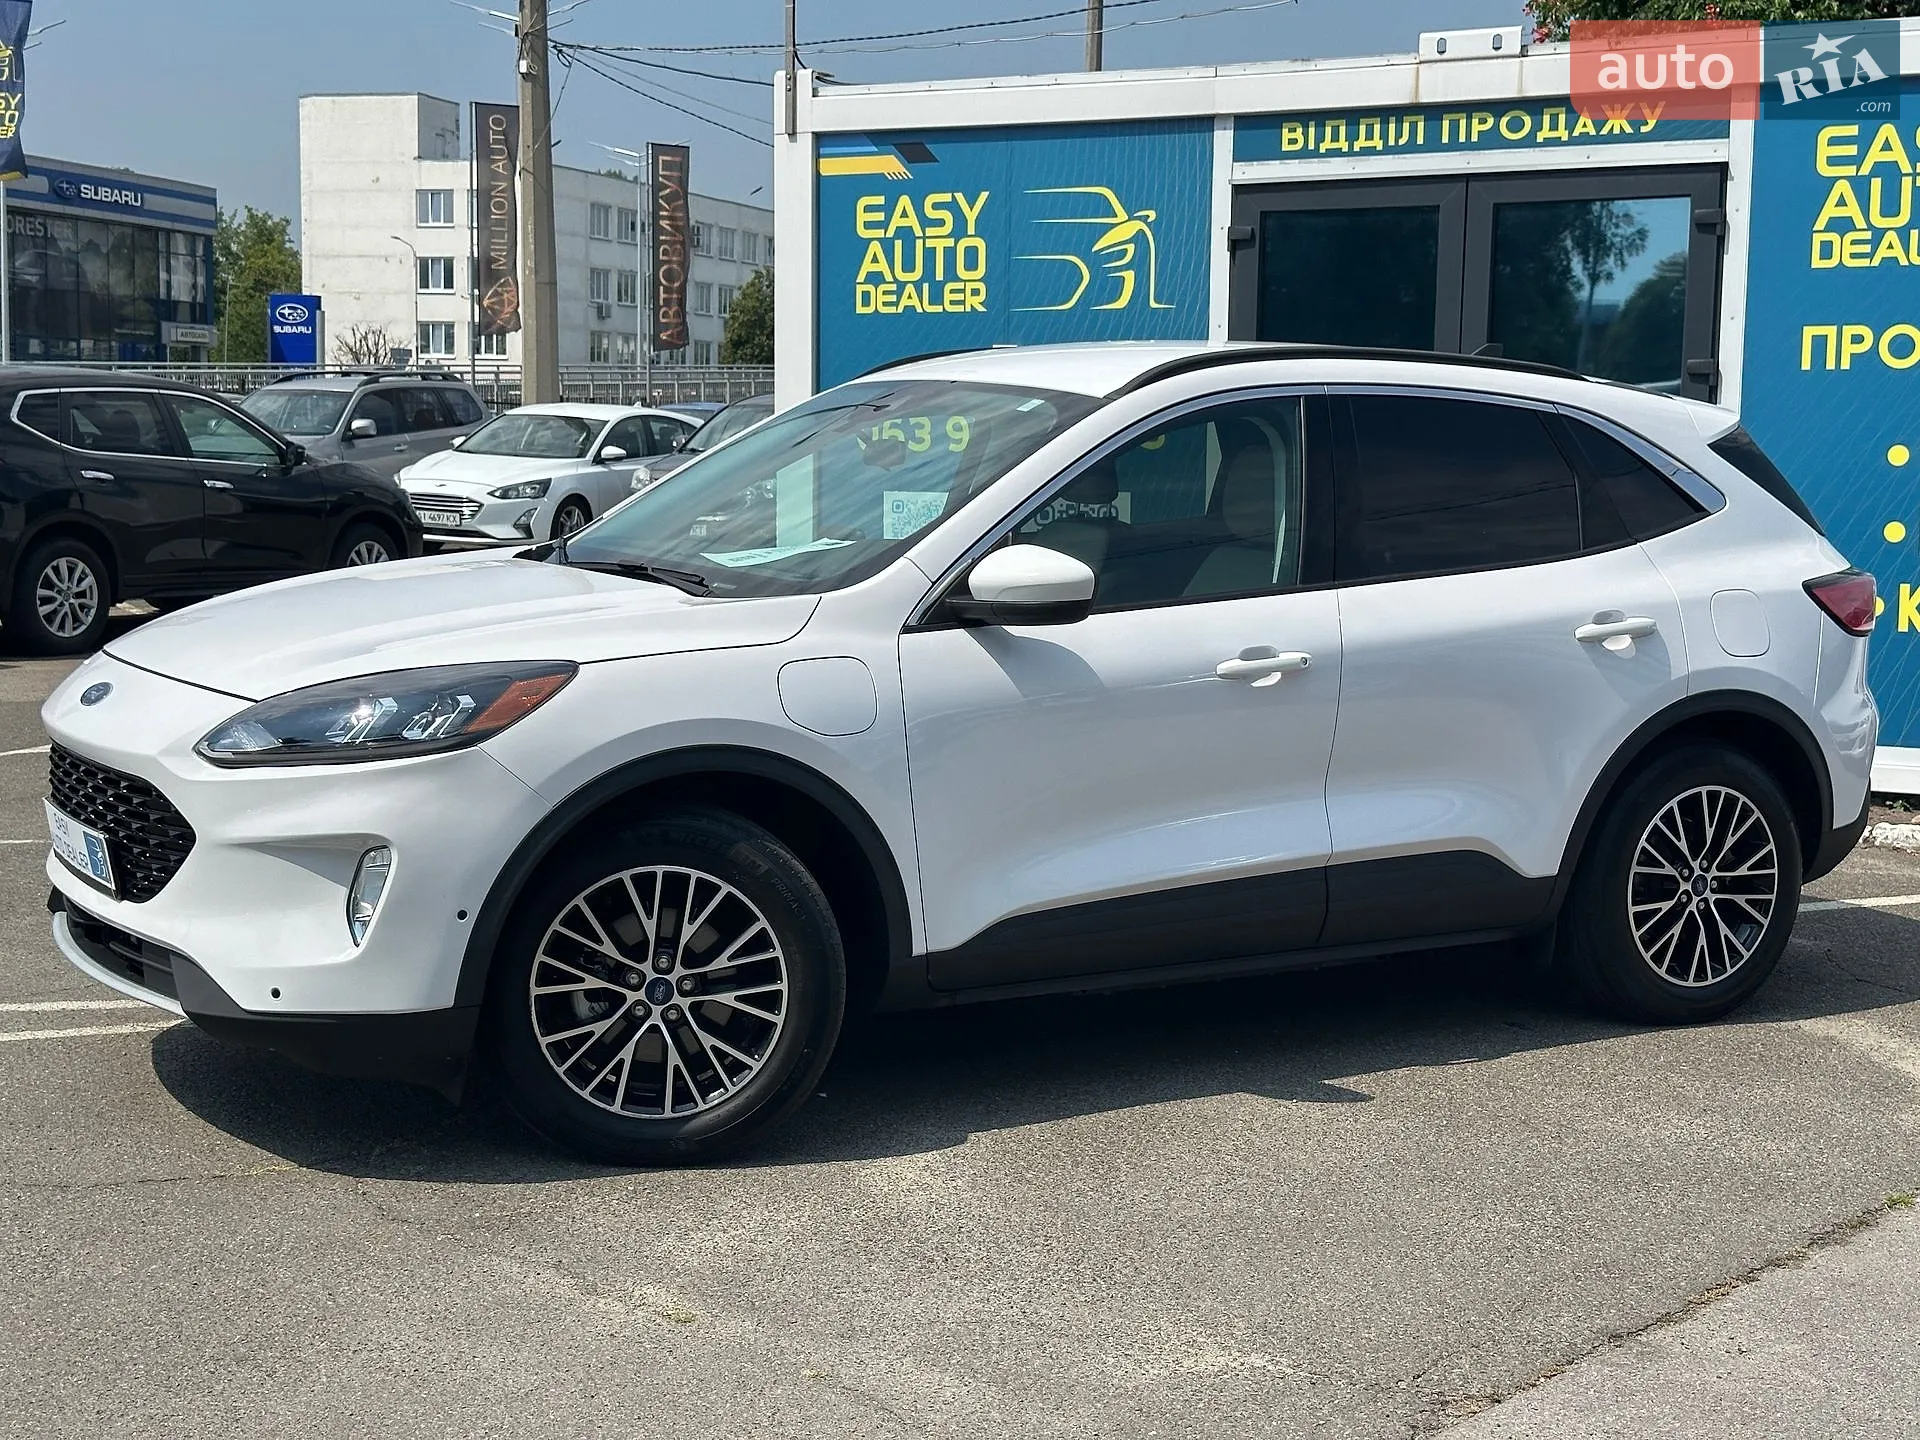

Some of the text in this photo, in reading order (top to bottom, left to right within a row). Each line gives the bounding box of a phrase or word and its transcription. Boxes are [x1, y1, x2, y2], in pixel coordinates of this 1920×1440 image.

[1281, 100, 1667, 153] ВІДДІЛ ПРОДАЖУ
[1816, 123, 1920, 177] EA
[80, 184, 141, 206] SUBARU
[489, 114, 508, 271] MILLION AUTO
[856, 191, 989, 238] EASY
[1812, 176, 1920, 231] AU
[659, 155, 684, 345] АВТОВИКУП
[856, 237, 987, 282] AUTO
[856, 281, 987, 314] DEALER
[273, 325, 312, 333] SUBARU
[53, 812, 70, 838] EASY
